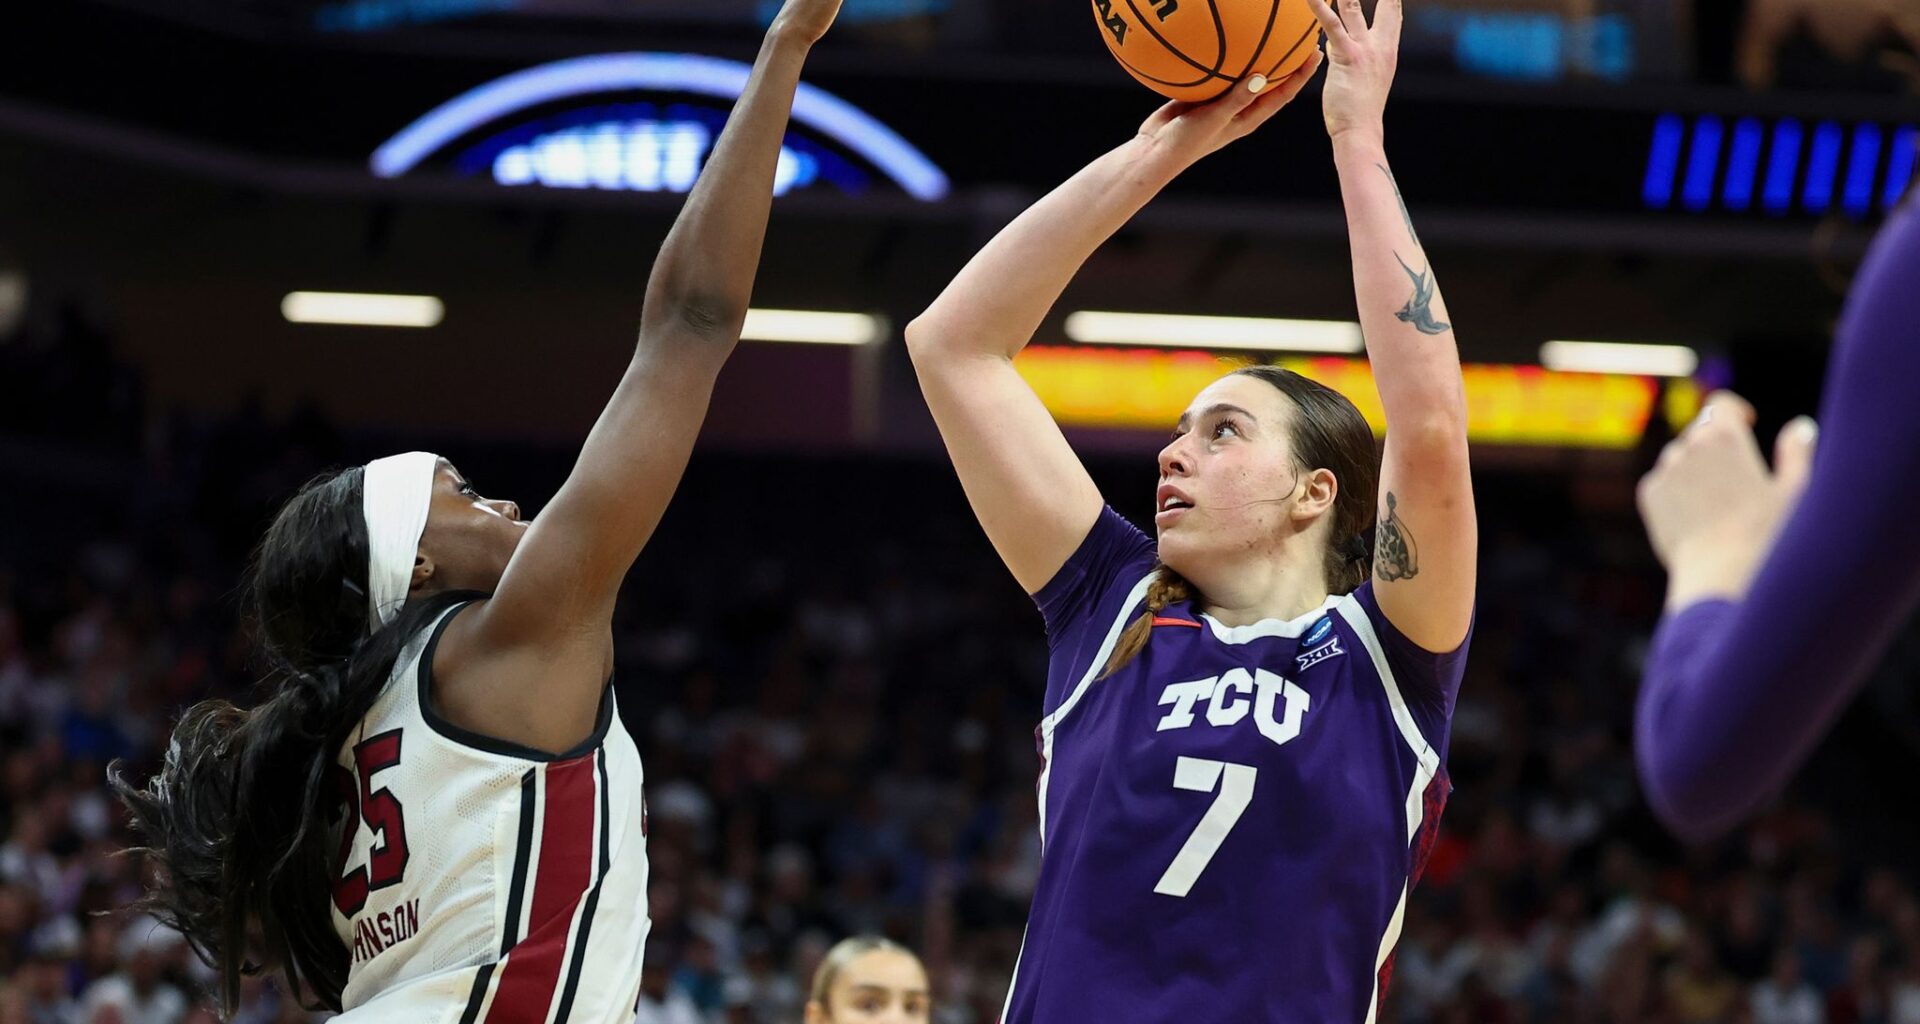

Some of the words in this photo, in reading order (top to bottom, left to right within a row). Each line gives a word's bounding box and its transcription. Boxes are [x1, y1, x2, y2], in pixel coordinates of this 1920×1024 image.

[1156, 667, 1311, 746] TCU
[331, 727, 410, 920] 25
[1153, 755, 1258, 898] 7
[351, 898, 420, 963] HNSON
